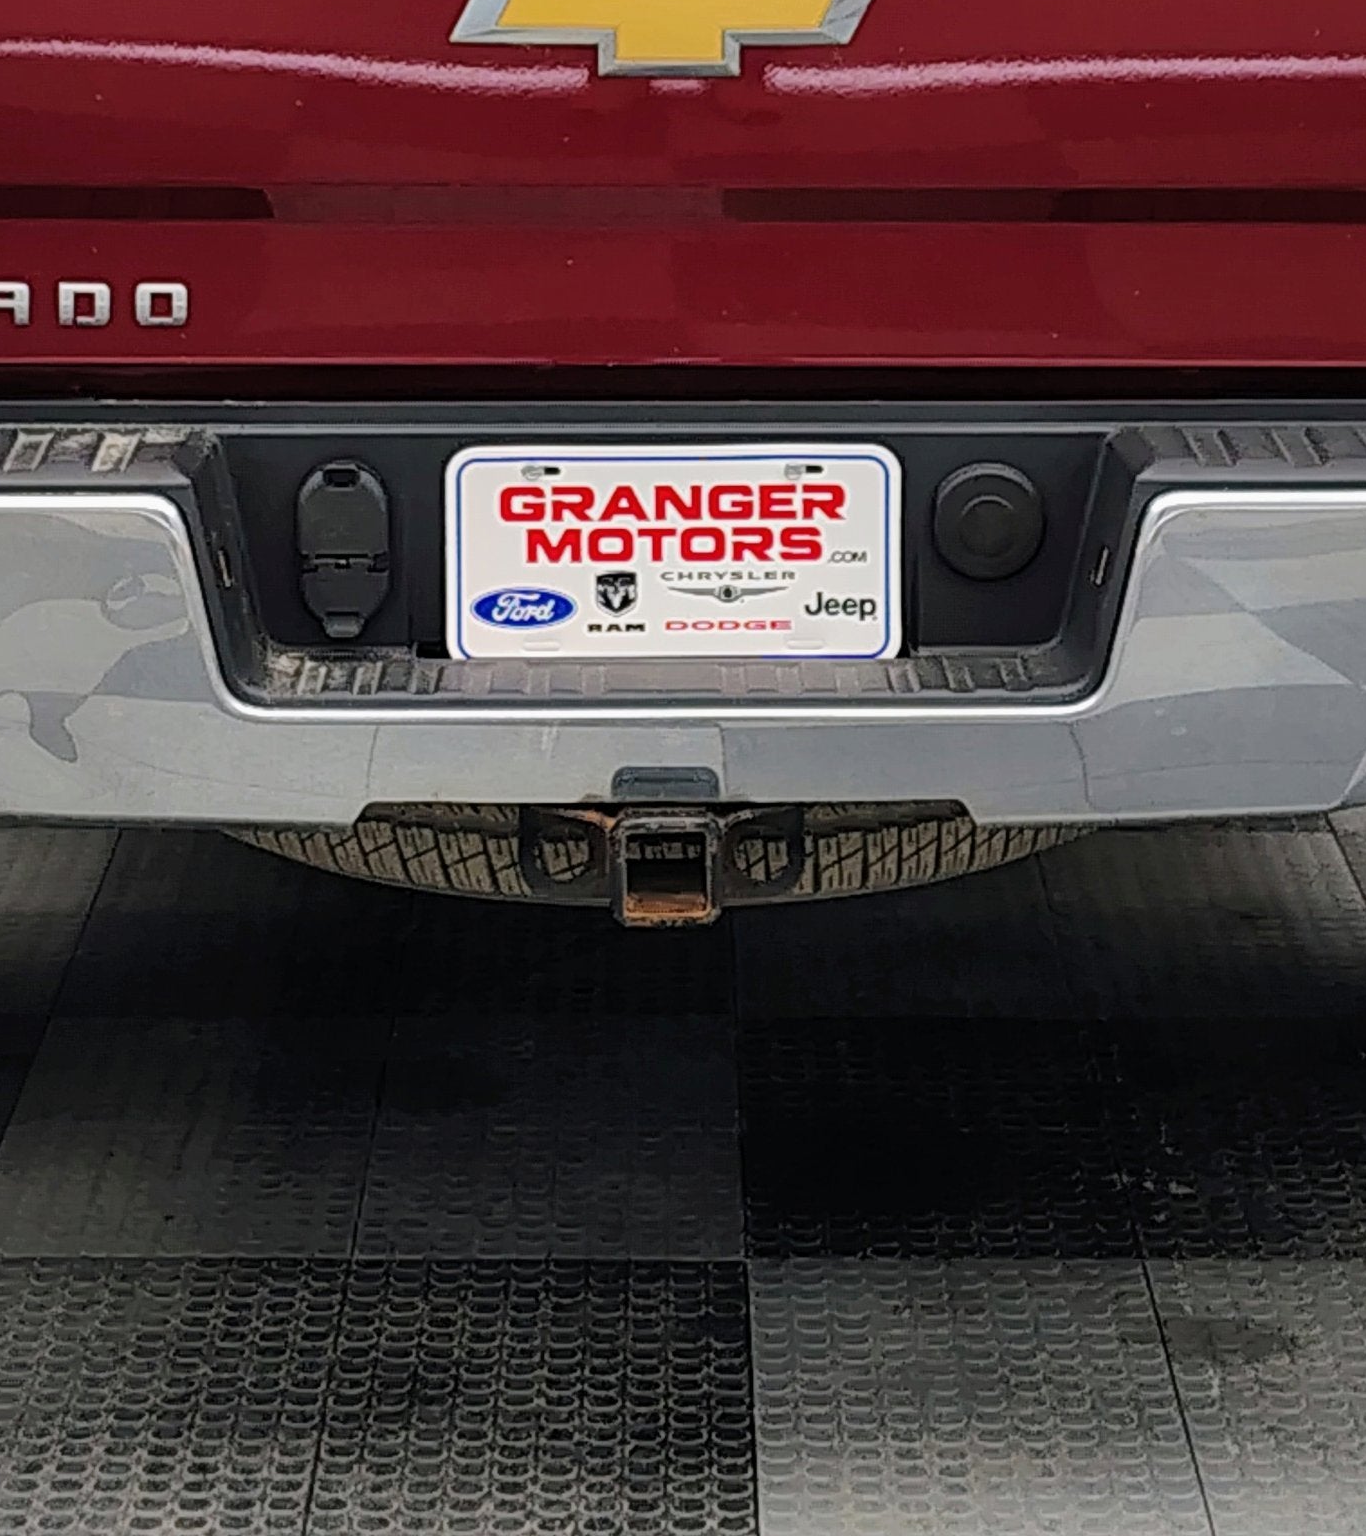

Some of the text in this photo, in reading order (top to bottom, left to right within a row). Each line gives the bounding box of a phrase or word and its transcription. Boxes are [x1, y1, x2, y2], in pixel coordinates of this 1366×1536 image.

[499, 484, 846, 522] GRANGER
[526, 527, 823, 564] MOTORS
[660, 570, 796, 581] CHRYSLER
[491, 591, 555, 622] Ford
[804, 591, 876, 621] Jeep
[587, 622, 646, 633] RAM
[664, 620, 792, 631] DODGE
